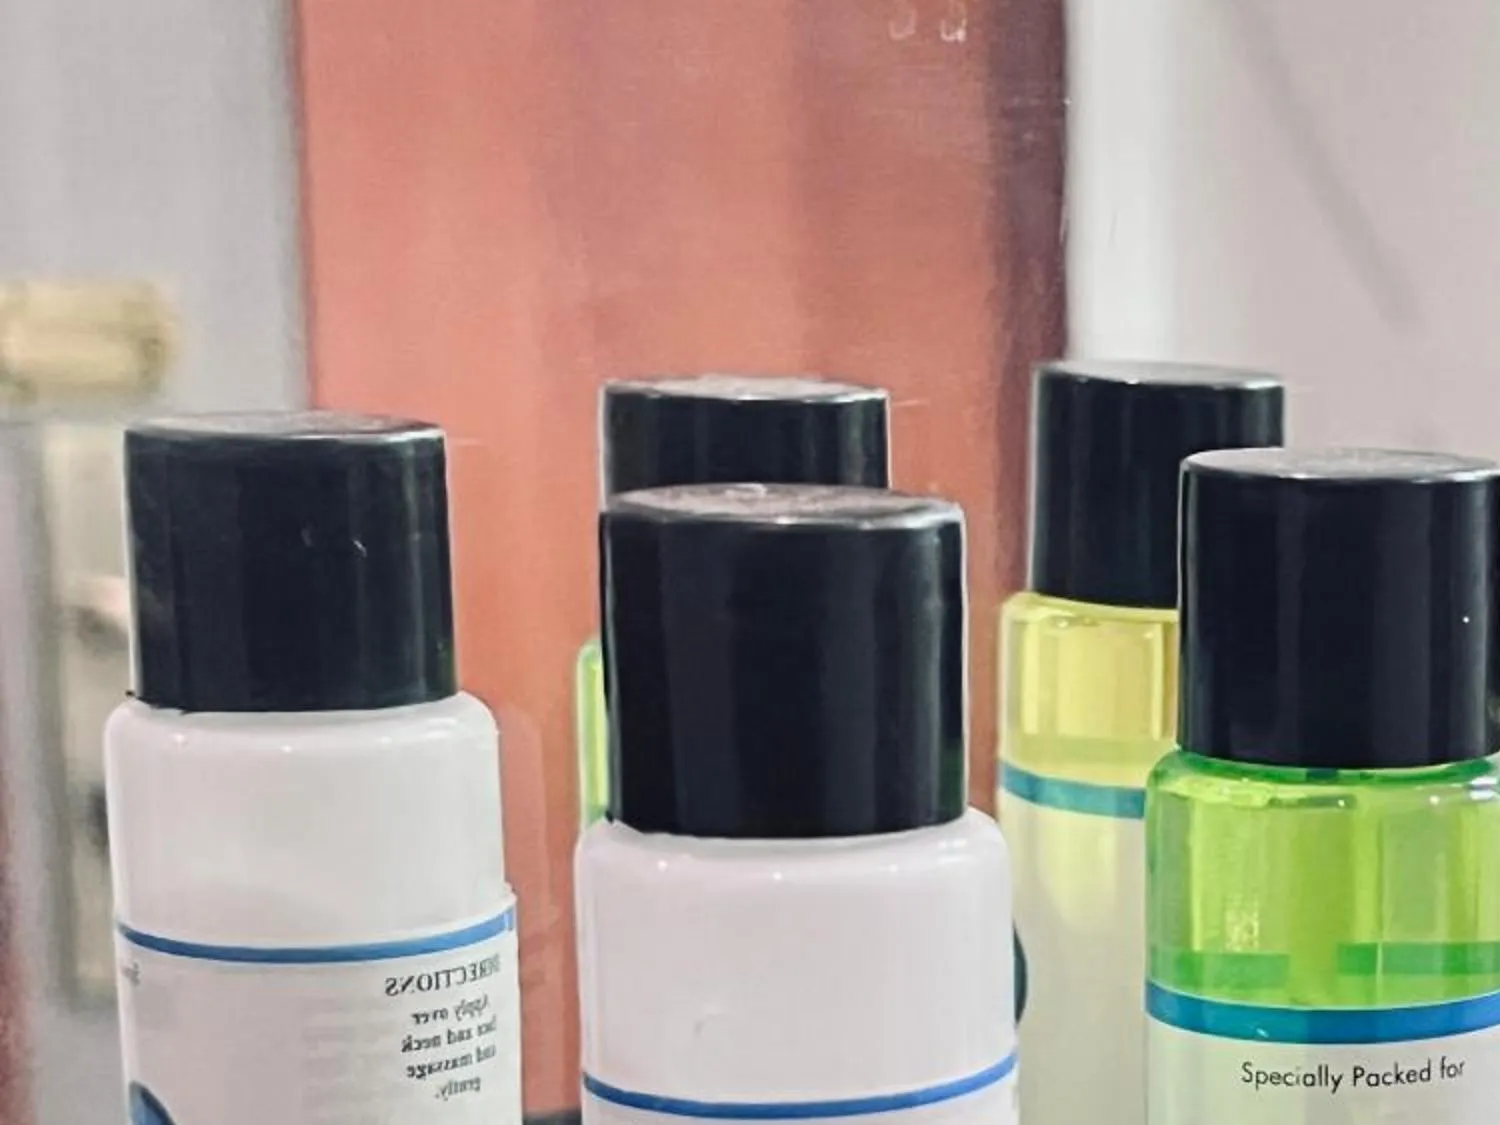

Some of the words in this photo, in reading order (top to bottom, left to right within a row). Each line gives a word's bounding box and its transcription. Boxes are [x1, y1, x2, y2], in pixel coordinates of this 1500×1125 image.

[1241, 1060, 1344, 1095] Specially
[1352, 1056, 1432, 1088] Packed
[1439, 1055, 1466, 1080] for
